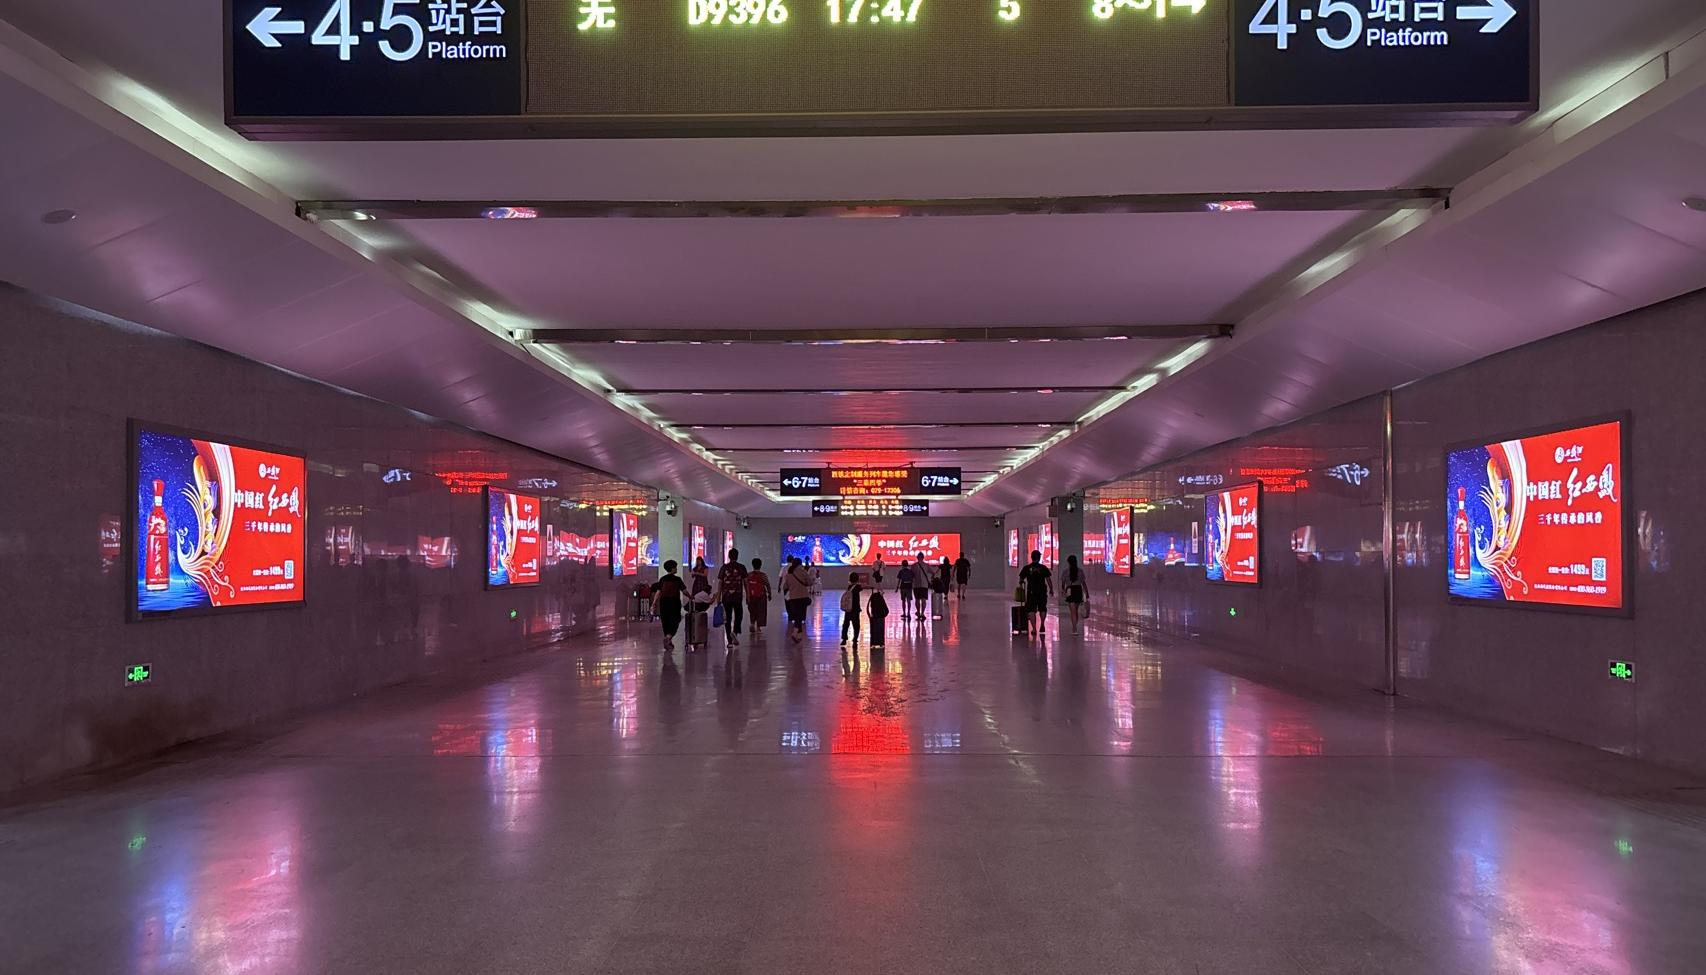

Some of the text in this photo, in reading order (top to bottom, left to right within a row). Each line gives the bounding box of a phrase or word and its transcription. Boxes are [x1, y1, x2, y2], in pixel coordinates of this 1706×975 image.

[428, 0, 506, 35] 站台
[687, 0, 788, 25] D9396
[1366, 28, 1448, 47] Platform
[428, 41, 506, 59] Platform
[234, 489, 265, 510] 中国红
[1527, 480, 1562, 502] 中国红
